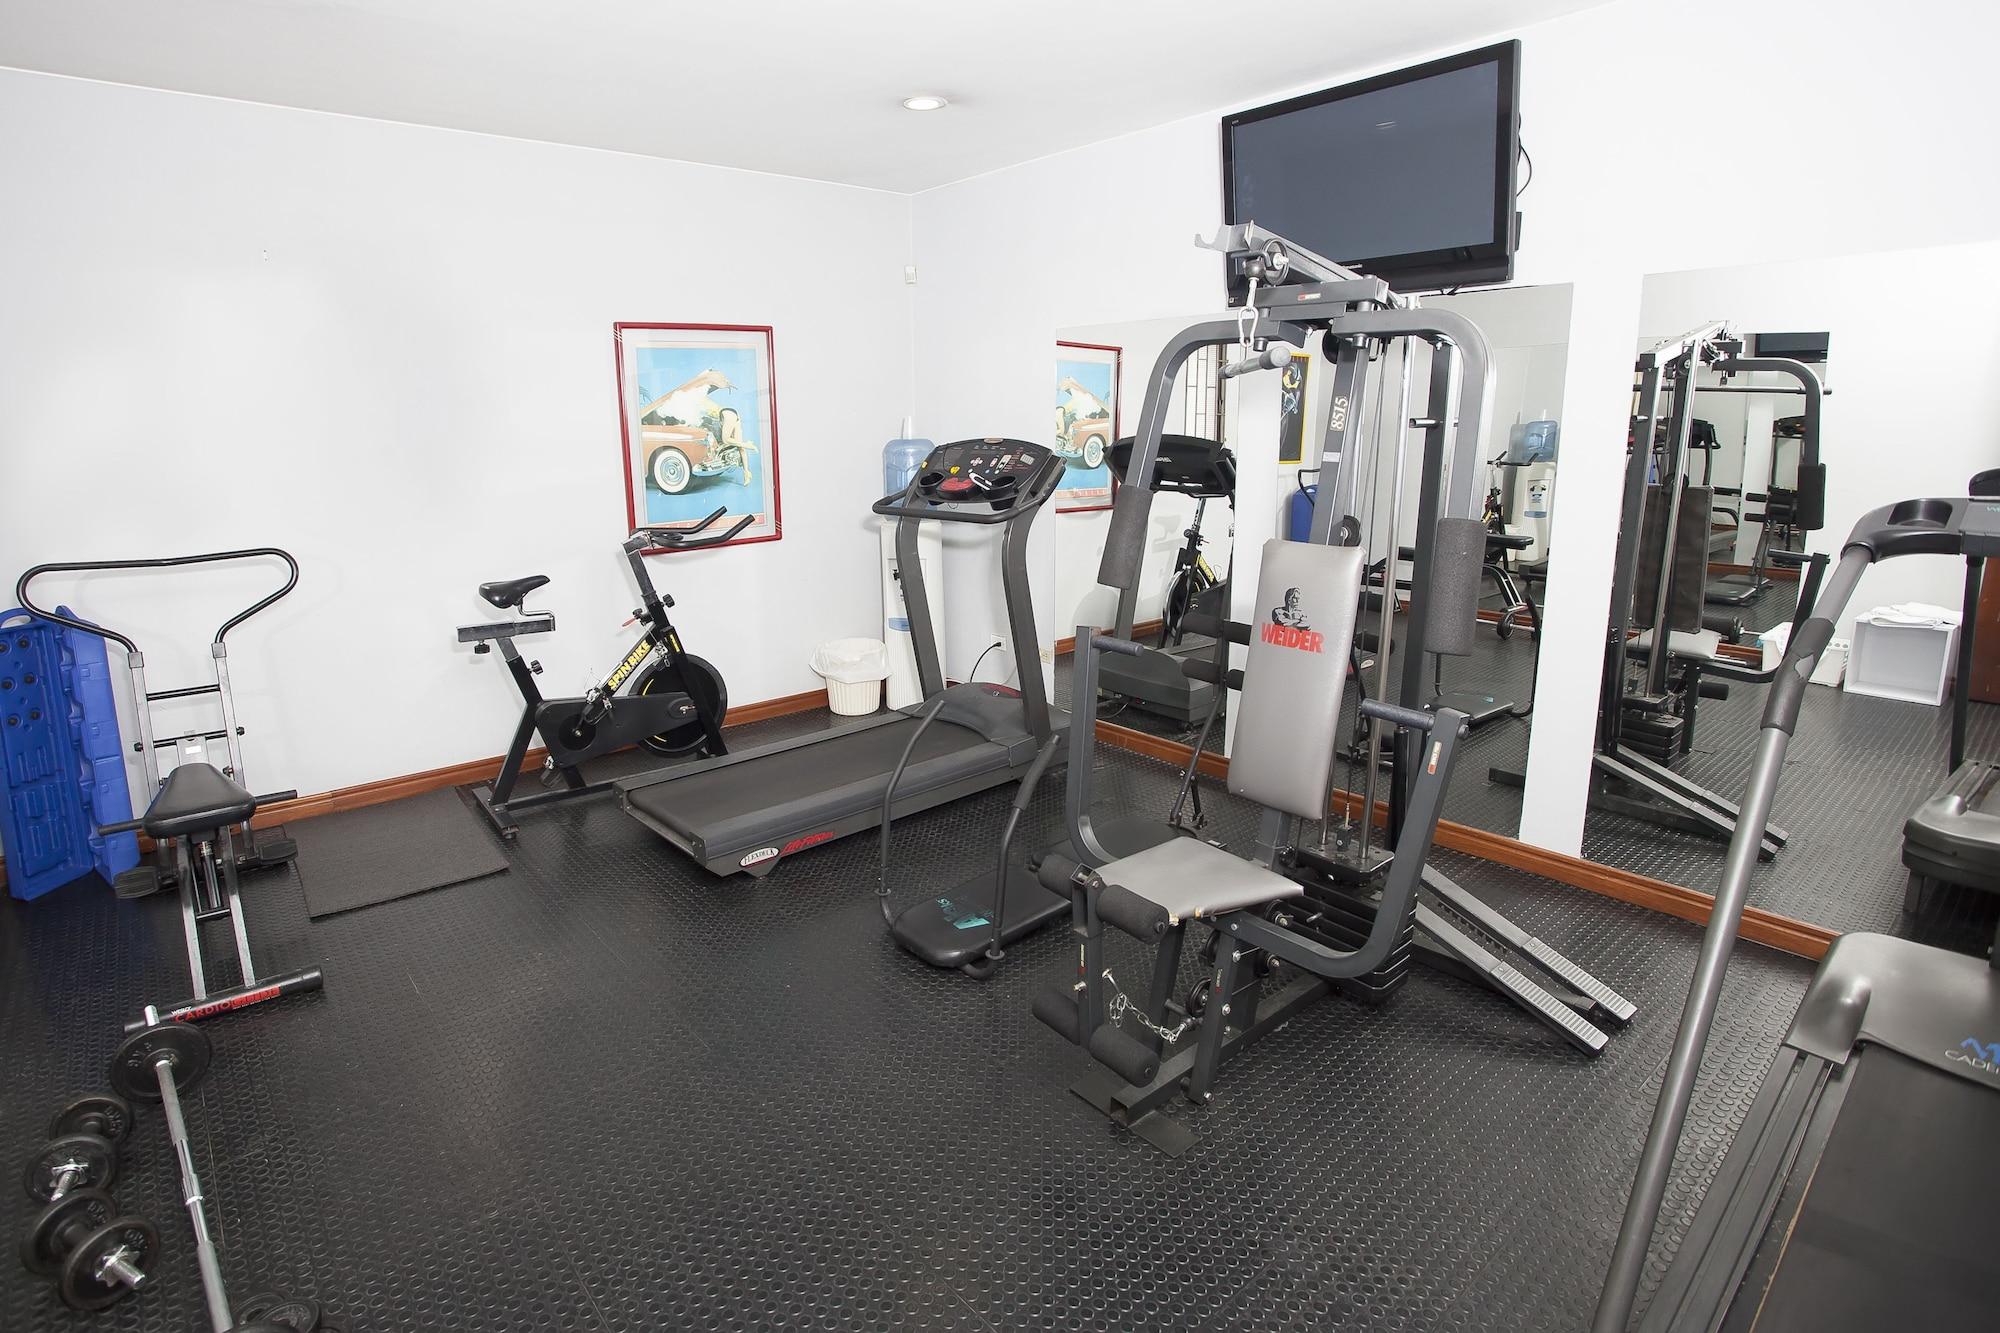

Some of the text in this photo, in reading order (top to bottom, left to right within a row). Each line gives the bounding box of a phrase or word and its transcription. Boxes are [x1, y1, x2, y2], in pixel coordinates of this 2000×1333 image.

[1331, 396, 1348, 429] 8515
[1261, 622, 1325, 653] WEIDER
[175, 1000, 231, 1022] CARDIO
